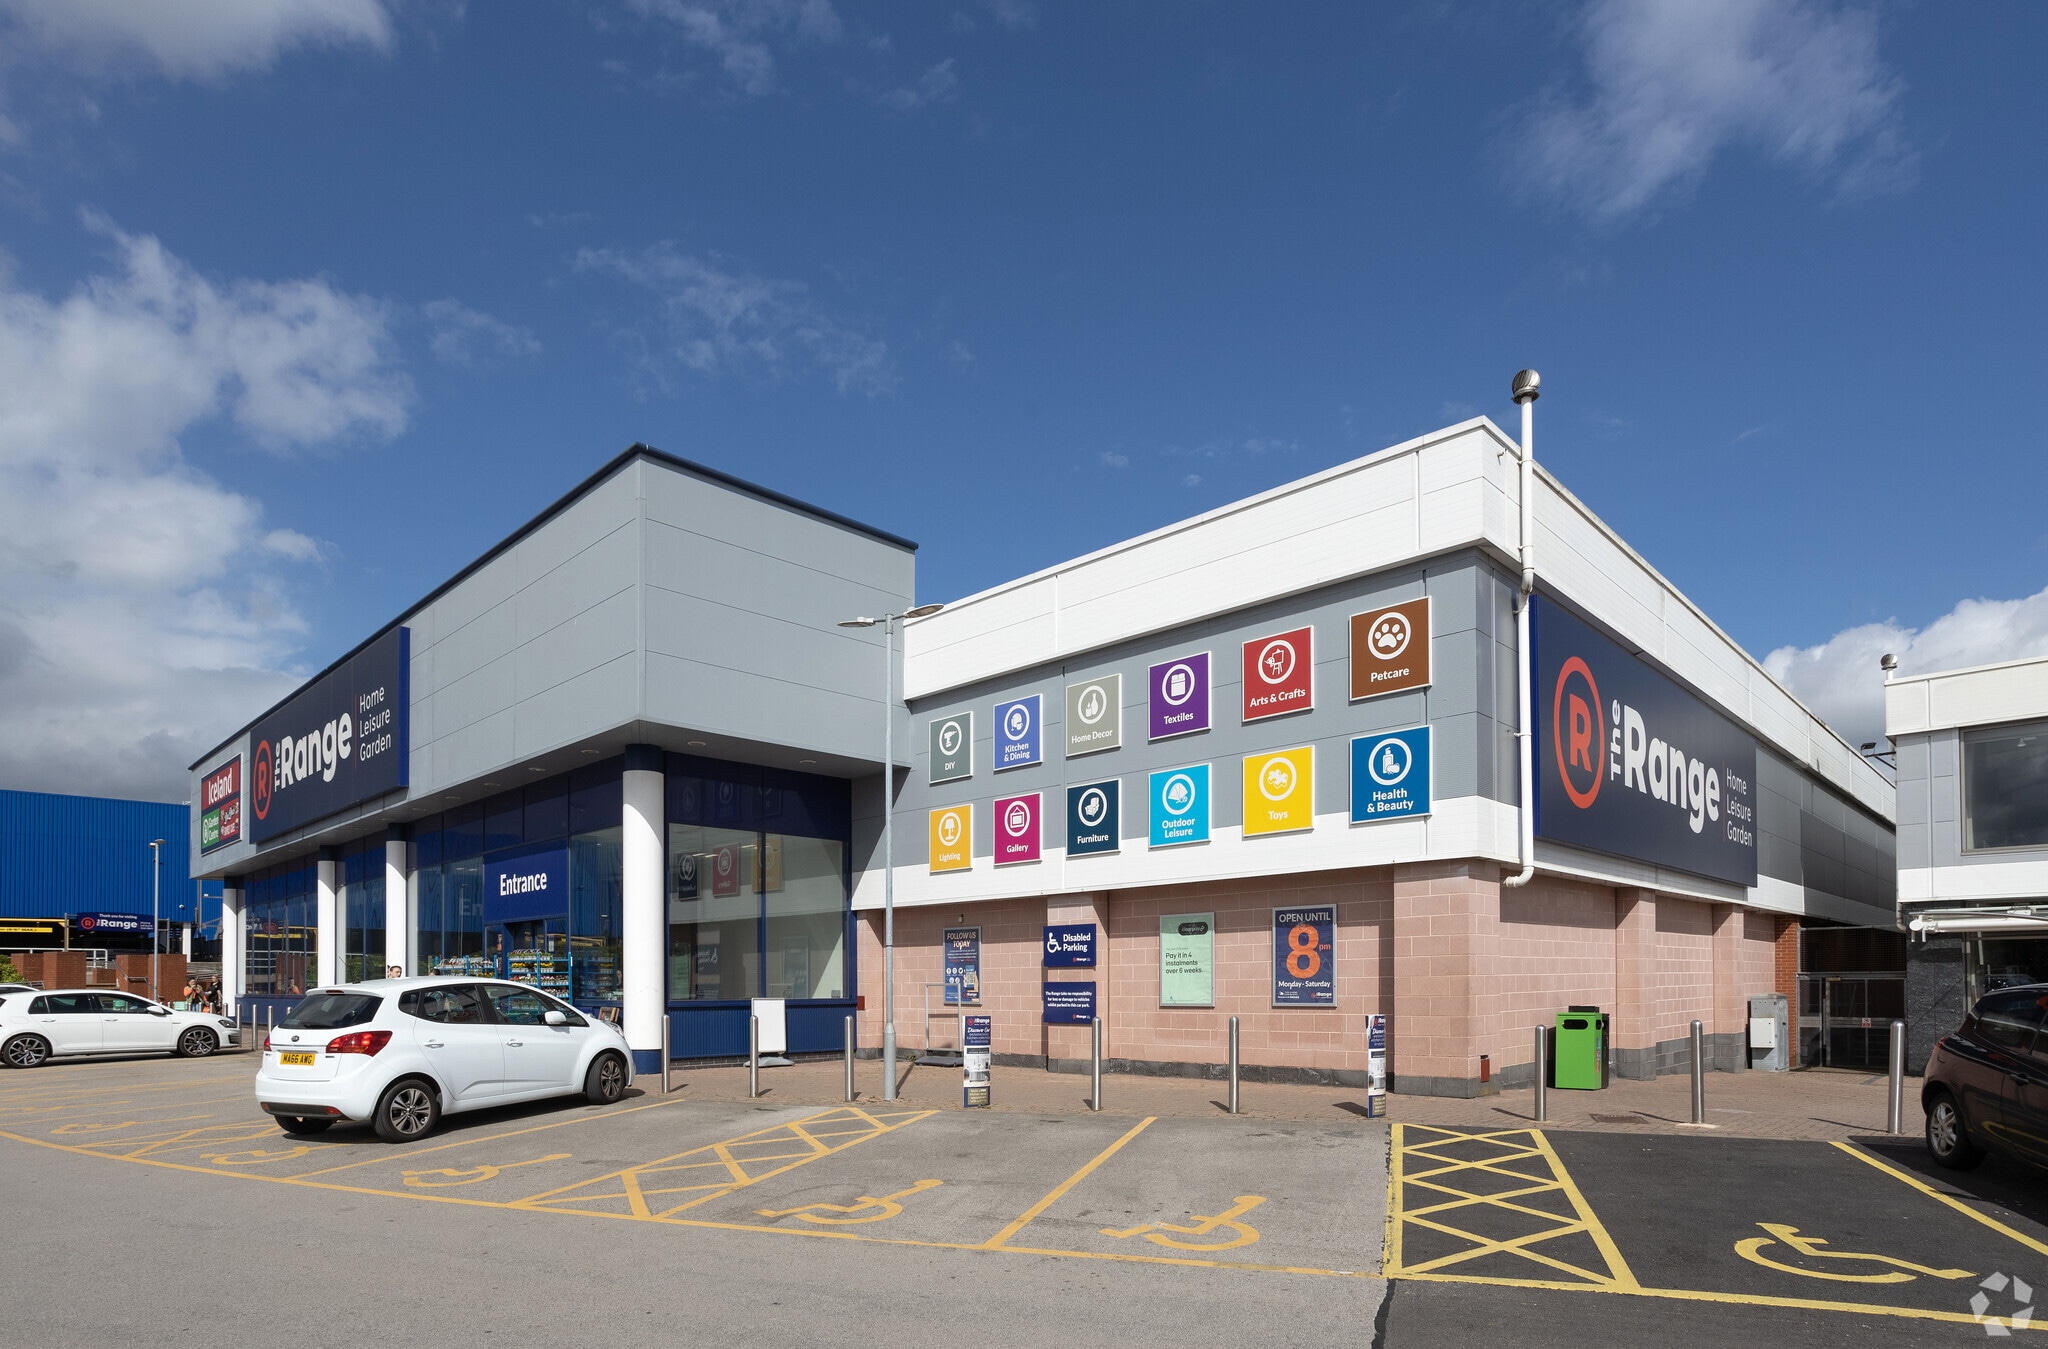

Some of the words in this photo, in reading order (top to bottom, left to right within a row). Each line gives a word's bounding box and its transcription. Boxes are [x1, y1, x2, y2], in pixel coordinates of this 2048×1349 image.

[1371, 667, 1409, 682] Petcare
[360, 687, 384, 713] Home
[1250, 696, 1268, 707] Arts
[1270, 693, 1277, 703] &
[1278, 688, 1306, 702] Crafts
[360, 709, 390, 738] Leisure
[1164, 712, 1194, 724] Textiles
[1071, 733, 1091, 744] Home
[1092, 729, 1112, 739] Decor
[281, 712, 352, 790] Range
[360, 734, 391, 761] Garden
[1005, 742, 1029, 753] Kitchen
[1010, 750, 1030, 761] Dining
[945, 761, 956, 771] DIY
[1611, 699, 1621, 781] The
[1624, 705, 1720, 834] Range
[209, 768, 232, 805] Iceland
[1727, 768, 1747, 795] Home
[1373, 788, 1407, 801] Health
[1367, 803, 1375, 813] &
[1377, 799, 1414, 812] Beauty
[1726, 795, 1751, 822] Leisure
[1268, 810, 1288, 820] Toys
[1162, 817, 1195, 829] Outdoor
[1077, 833, 1108, 844] Furniture
[1165, 827, 1193, 838] Leisure
[1727, 822, 1752, 847] Garden
[1007, 843, 1028, 854] Gallery
[939, 852, 960, 862] Lighting
[500, 872, 547, 896] Entrance
[1279, 914, 1303, 922] OPEN
[1305, 912, 1331, 921] UNTIL
[101, 919, 137, 929] Range
[947, 932, 968, 940] FOLLOW
[1063, 933, 1090, 942] Disabled
[953, 940, 970, 948] TODAY
[1063, 943, 1088, 952] Parking
[1286, 923, 1320, 978] 8
[283, 1054, 298, 1063] MA66
[300, 1056, 312, 1064] AWG
